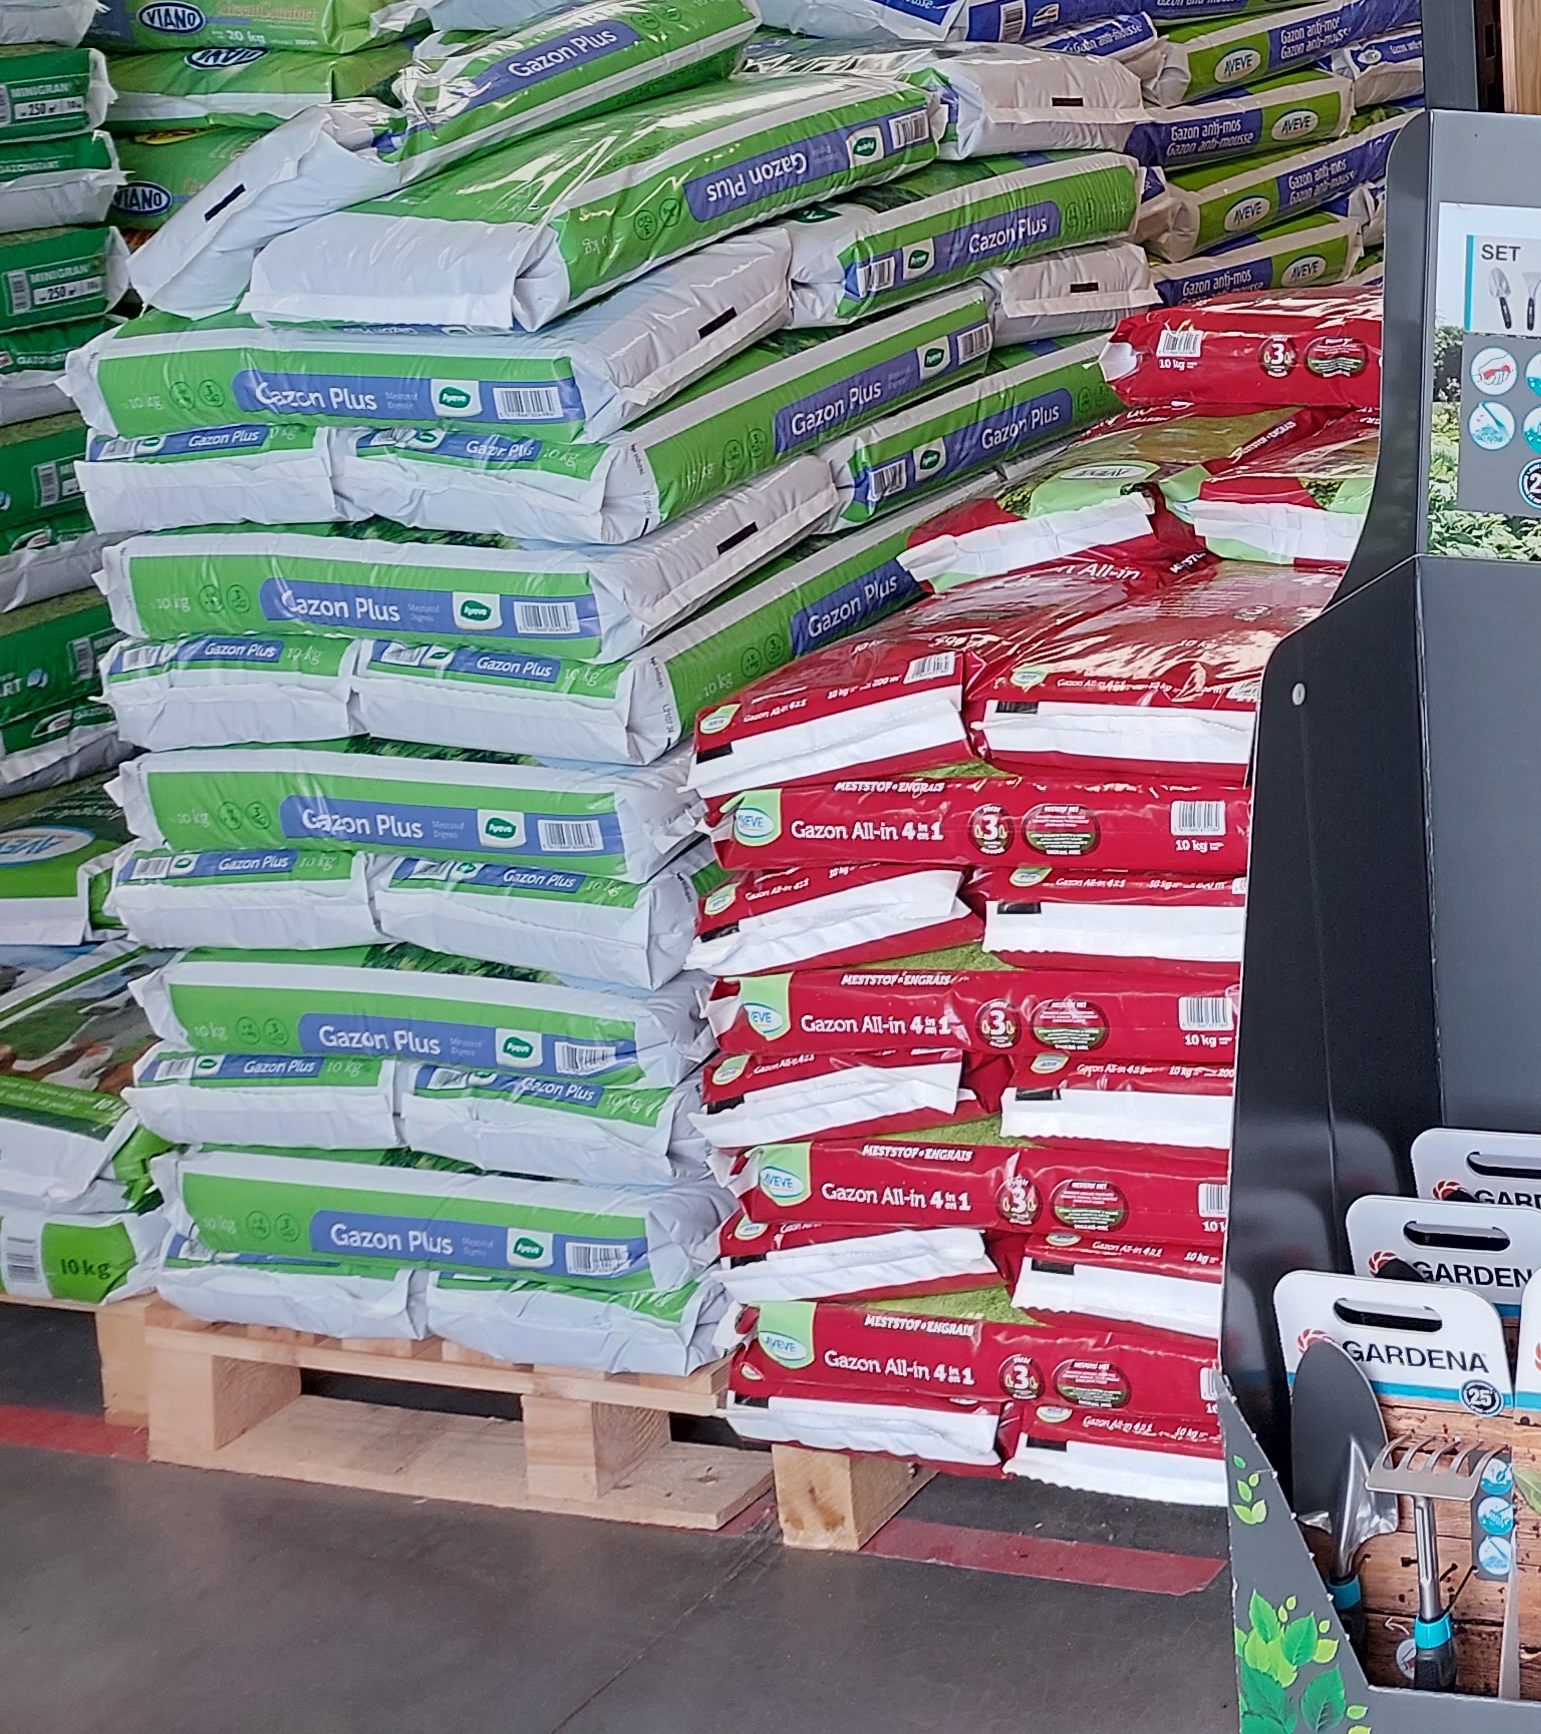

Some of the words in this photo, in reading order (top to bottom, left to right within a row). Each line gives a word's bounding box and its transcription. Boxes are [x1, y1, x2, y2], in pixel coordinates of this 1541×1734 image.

[145, 7, 199, 30] VIANO
[508, 39, 574, 79] Gazon
[576, 27, 619, 60] Plus
[12, 82, 68, 98] MINIGRAN
[1481, 243, 1519, 263] SET
[283, 589, 346, 621] Gazon
[354, 596, 401, 623] Plus
[790, 820, 847, 842] Gazon
[851, 824, 899, 841] All-in
[61, 1259, 78, 1278] 10
[82, 1260, 112, 1282] kg
[1342, 1340, 1490, 1374] GARDENA
